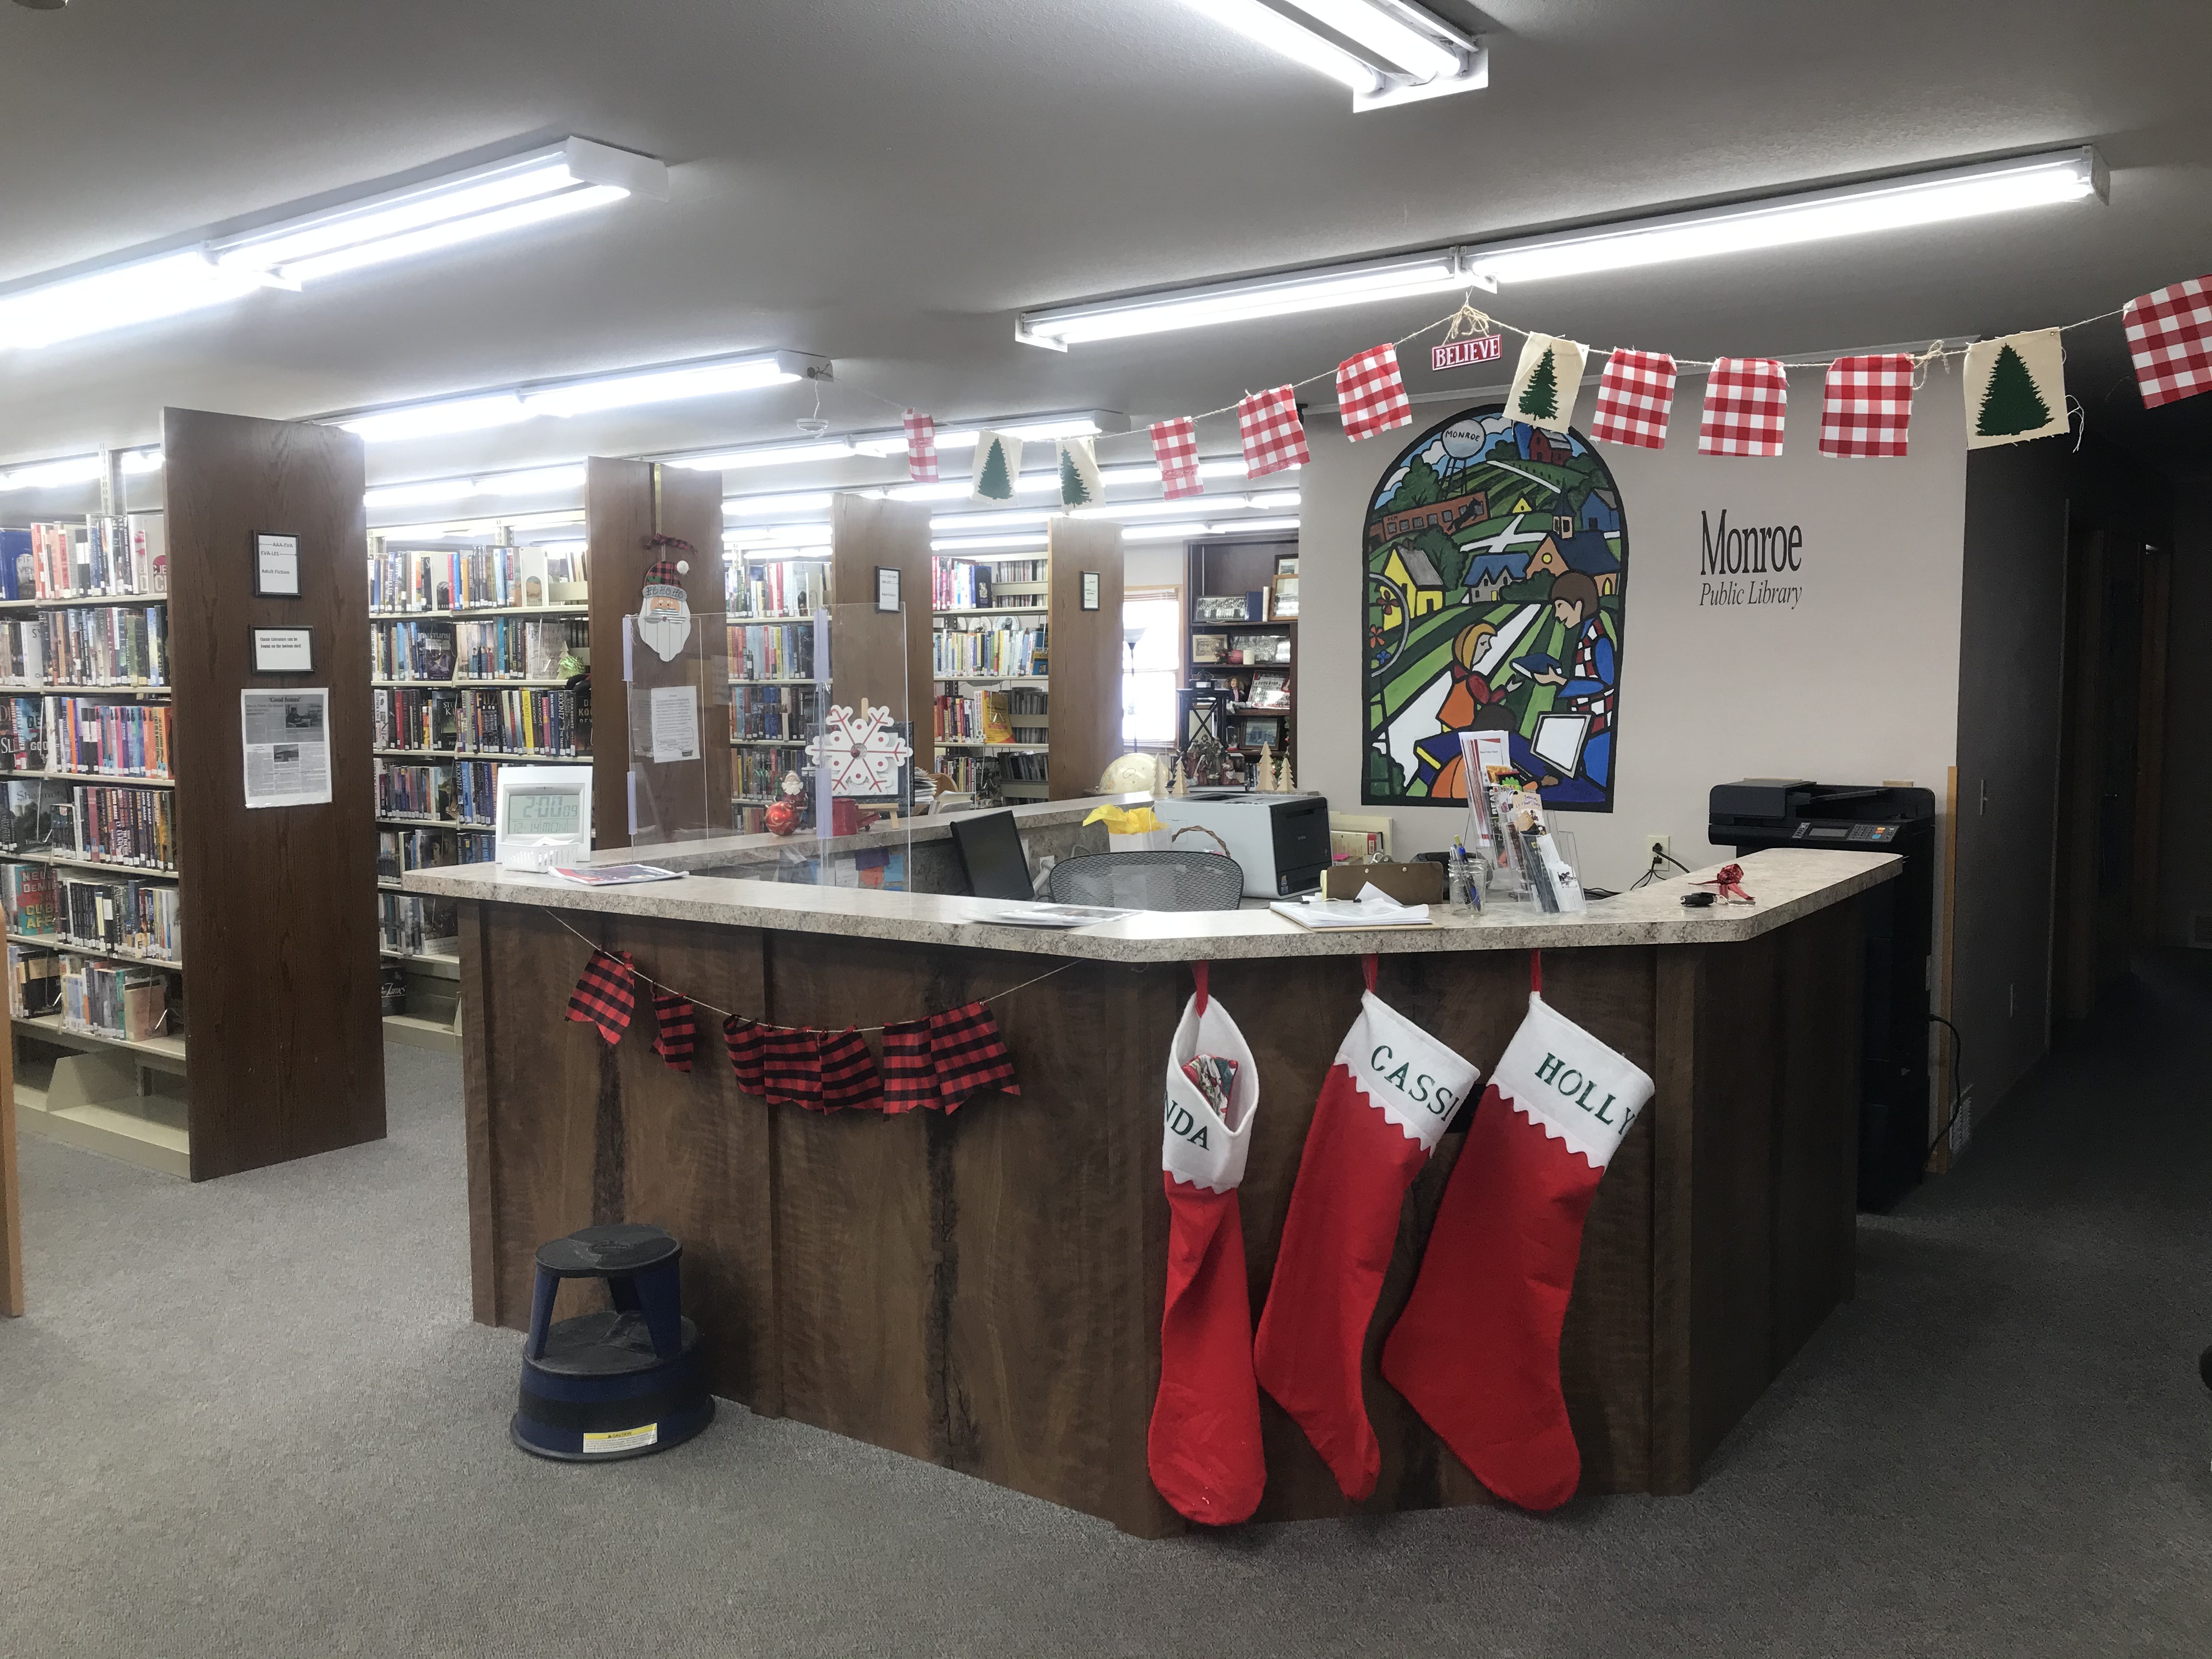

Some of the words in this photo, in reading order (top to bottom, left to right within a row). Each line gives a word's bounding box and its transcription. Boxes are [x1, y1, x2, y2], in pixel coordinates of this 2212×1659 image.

[1436, 338, 1499, 367] BELIEVE
[1445, 430, 1480, 442] MONROE
[1700, 509, 1803, 575] Monroe
[646, 587, 658, 596] HO
[659, 587, 672, 596] HO
[673, 588, 684, 599] HO
[1699, 580, 1745, 606] Public
[1747, 579, 1803, 610] Library
[1534, 1052, 1635, 1135] HOLLY
